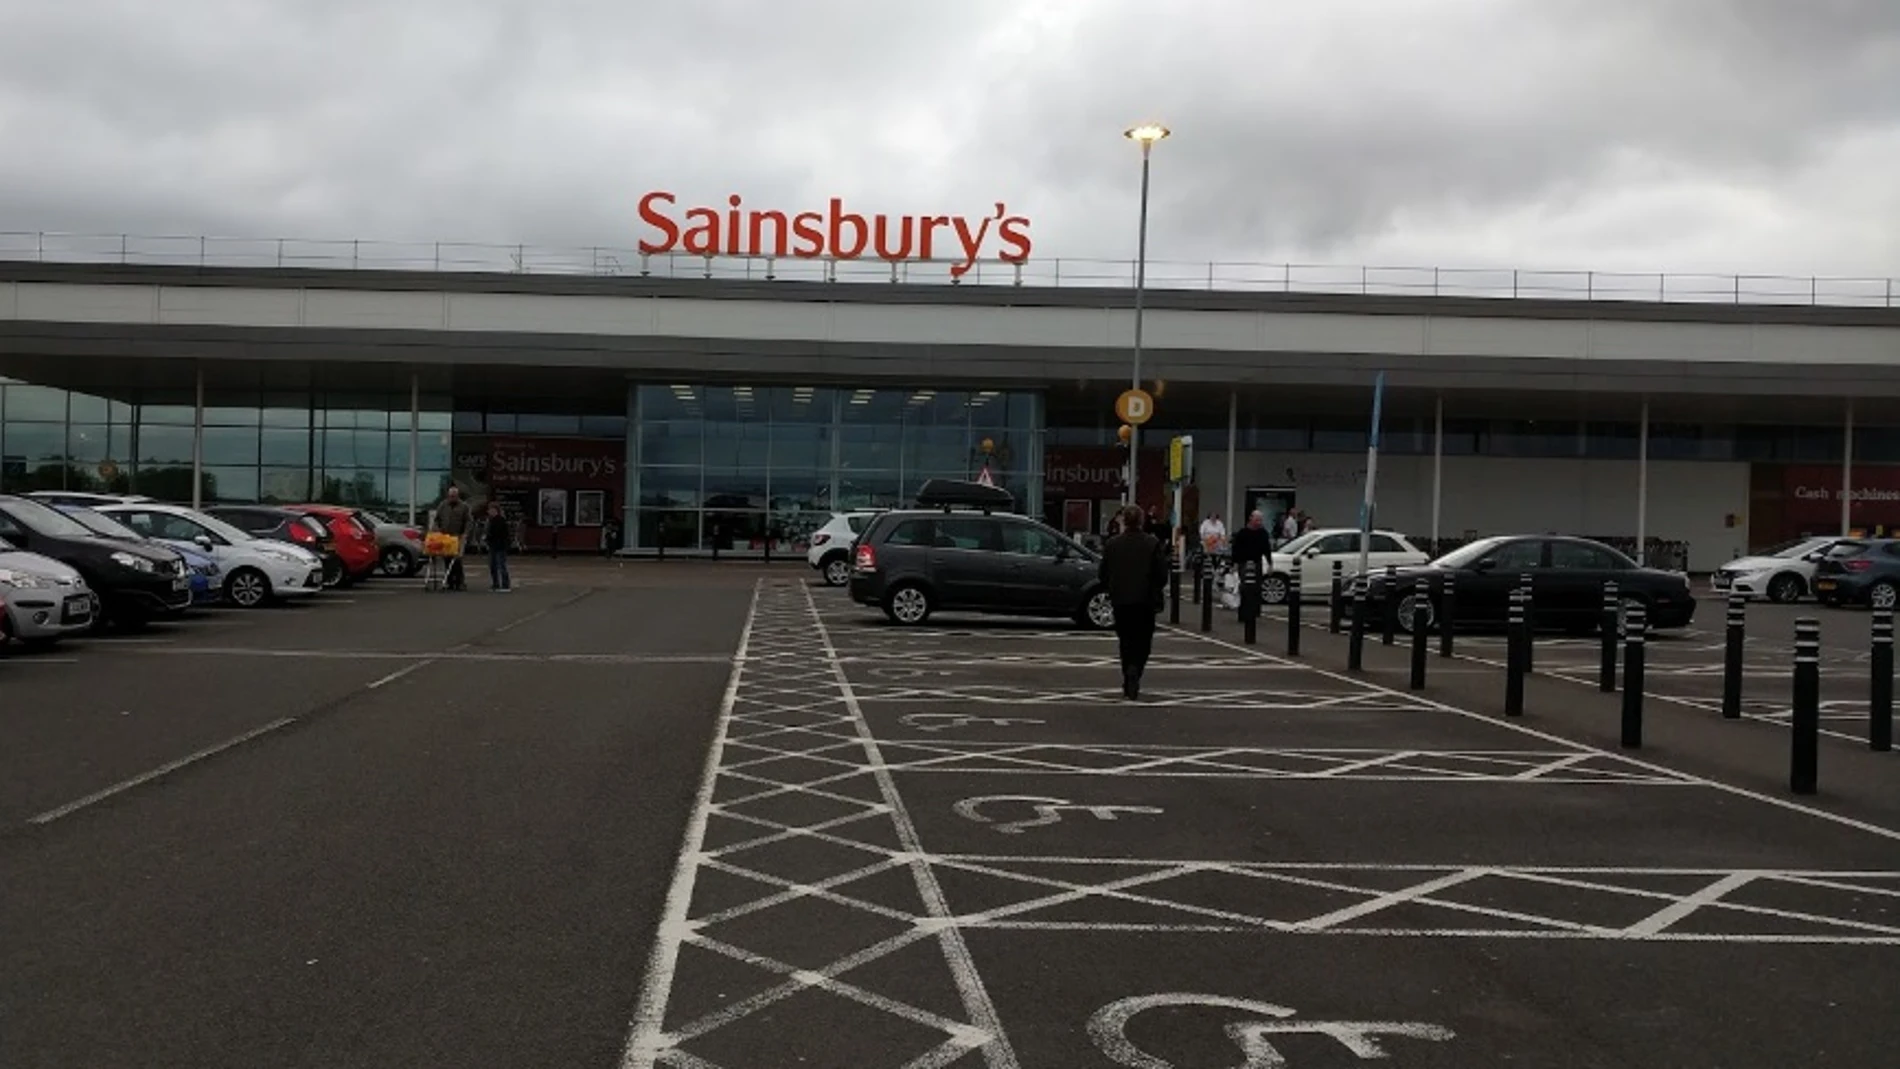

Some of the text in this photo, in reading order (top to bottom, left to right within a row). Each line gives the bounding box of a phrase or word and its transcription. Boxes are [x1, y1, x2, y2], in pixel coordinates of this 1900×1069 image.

[637, 191, 1031, 277] Sainsbury's
[1127, 395, 1145, 417] D
[492, 450, 617, 479] Sainsbury's
[1794, 485, 1830, 500] Cash
